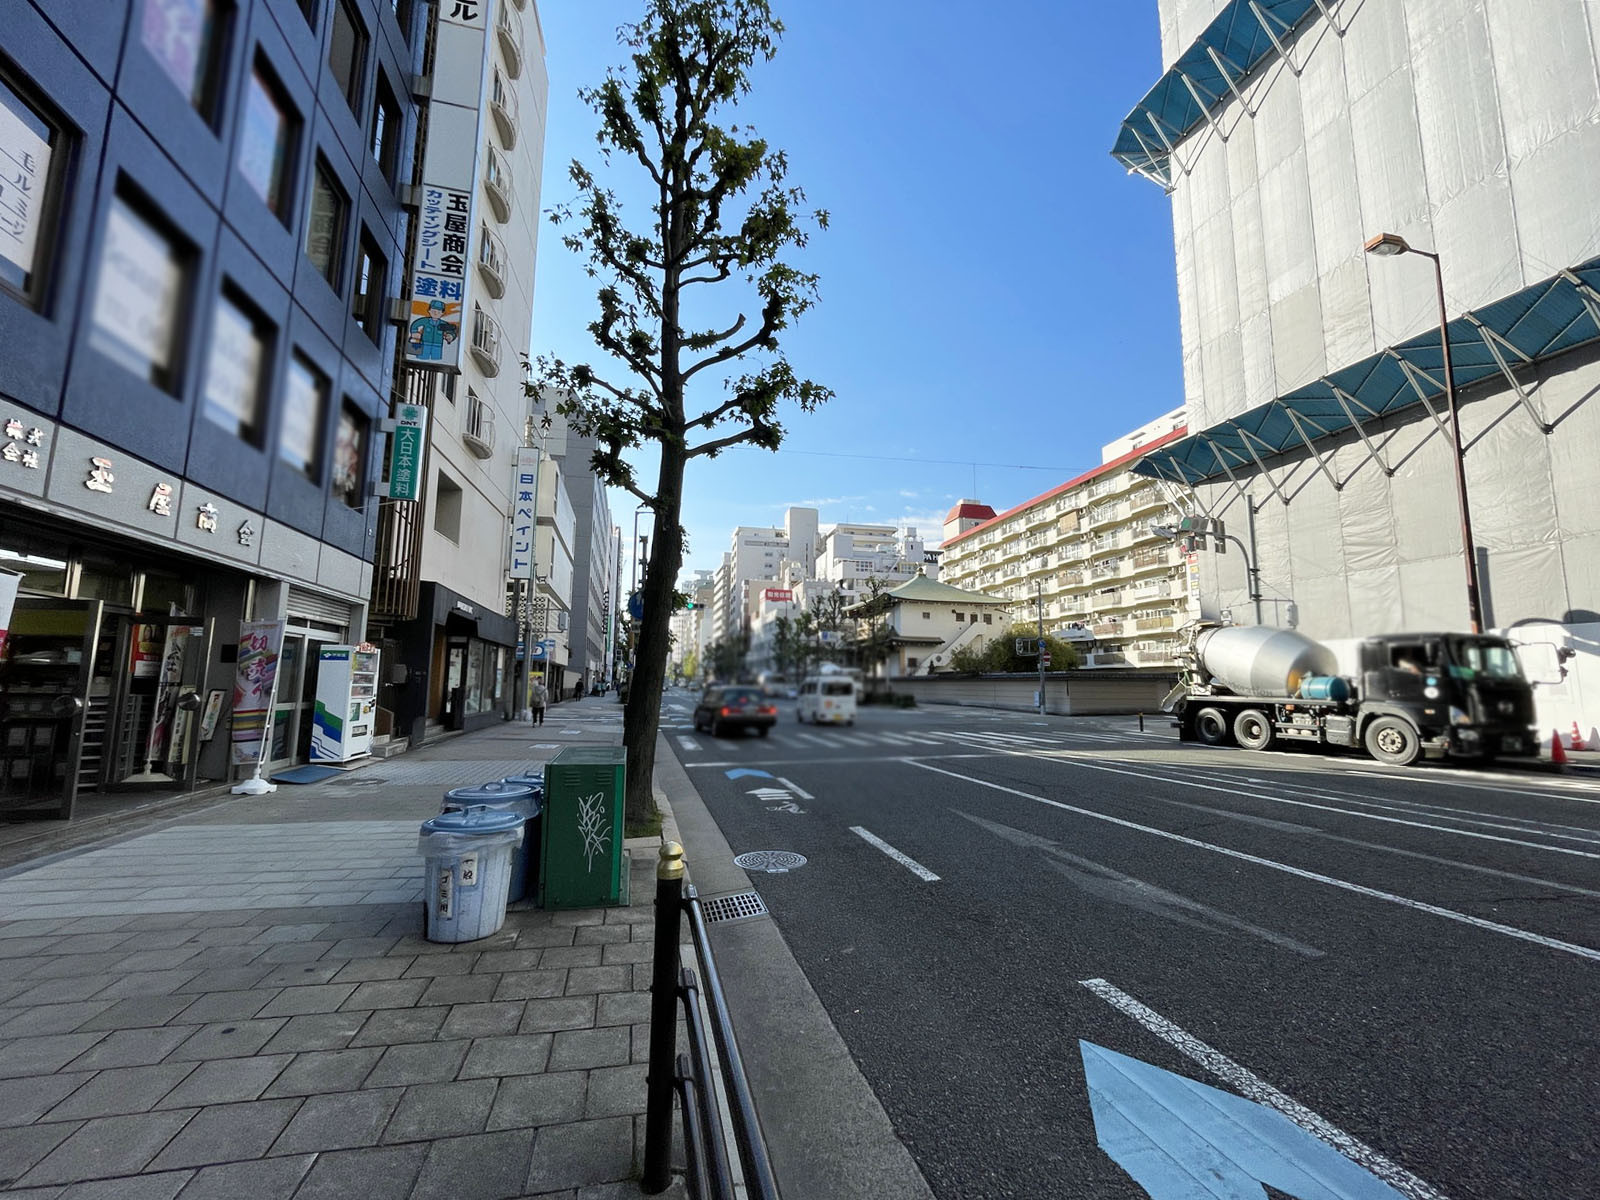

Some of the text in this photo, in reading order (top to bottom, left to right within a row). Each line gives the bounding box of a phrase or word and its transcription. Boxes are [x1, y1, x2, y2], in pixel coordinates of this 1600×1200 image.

[450, 0, 478, 21] ル
[421, 190, 442, 268] カッティングシート
[441, 193, 468, 275] 玉屋商会
[415, 276, 461, 301] 塗料
[394, 428, 415, 496] 大日本塗料
[514, 473, 534, 569] 日本ペイント
